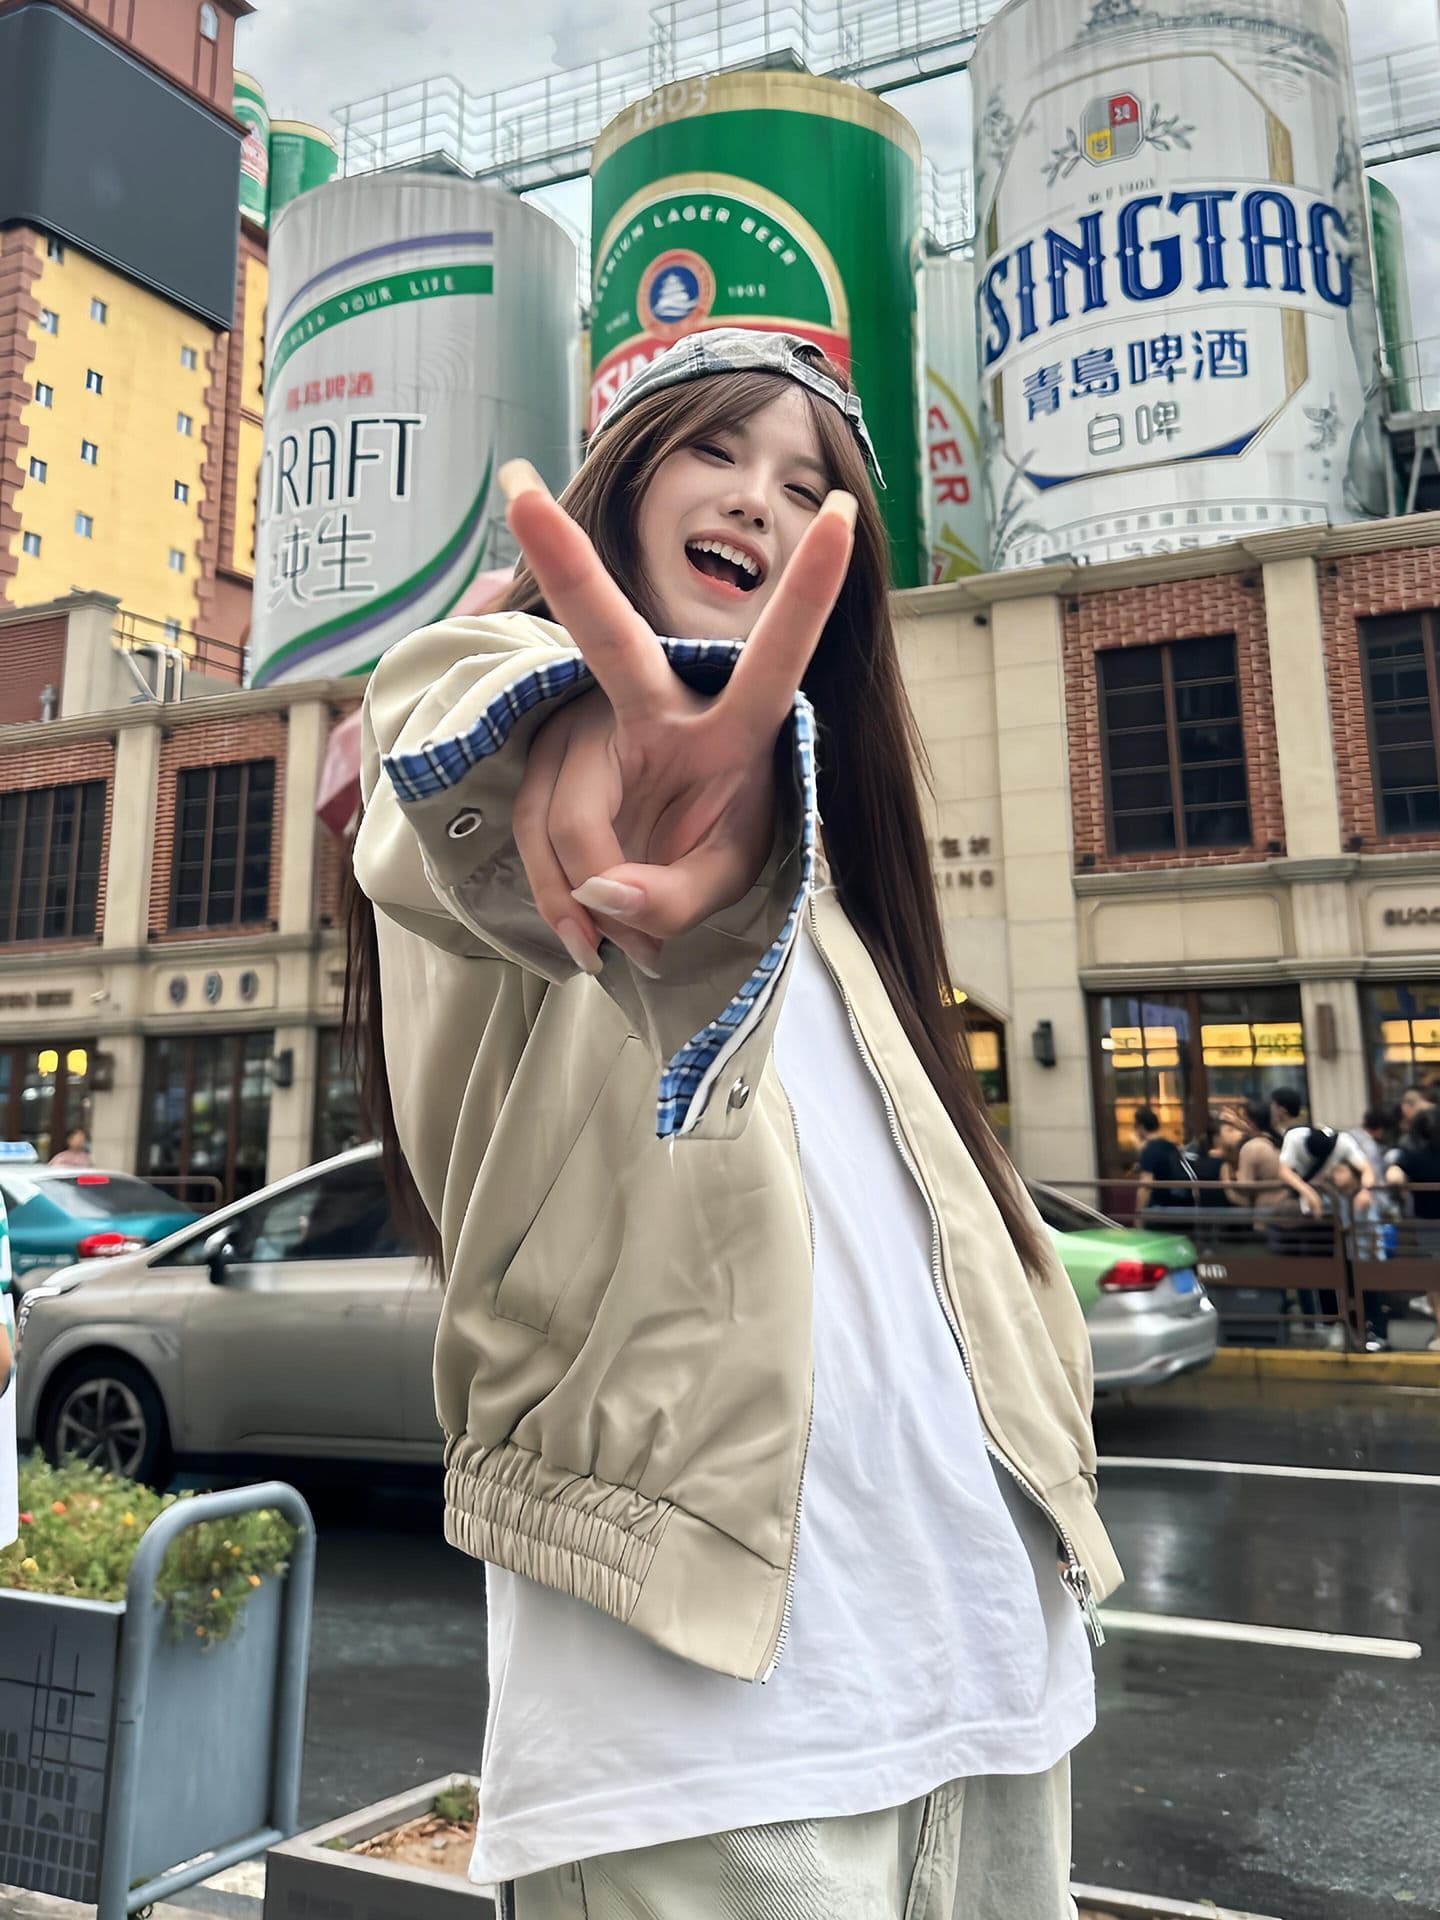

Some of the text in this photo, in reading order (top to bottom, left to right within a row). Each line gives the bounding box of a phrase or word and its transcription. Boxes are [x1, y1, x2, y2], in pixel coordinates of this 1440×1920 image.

[652, 204, 731, 229] LAGER
[740, 216, 798, 266] BEER
[338, 286, 393, 315] YOUR
[980, 190, 1353, 367] SINGTAO
[1022, 328, 1250, 422] 青島啤酒
[265, 418, 422, 516] RAFT
[1087, 402, 1182, 456] 白啤
